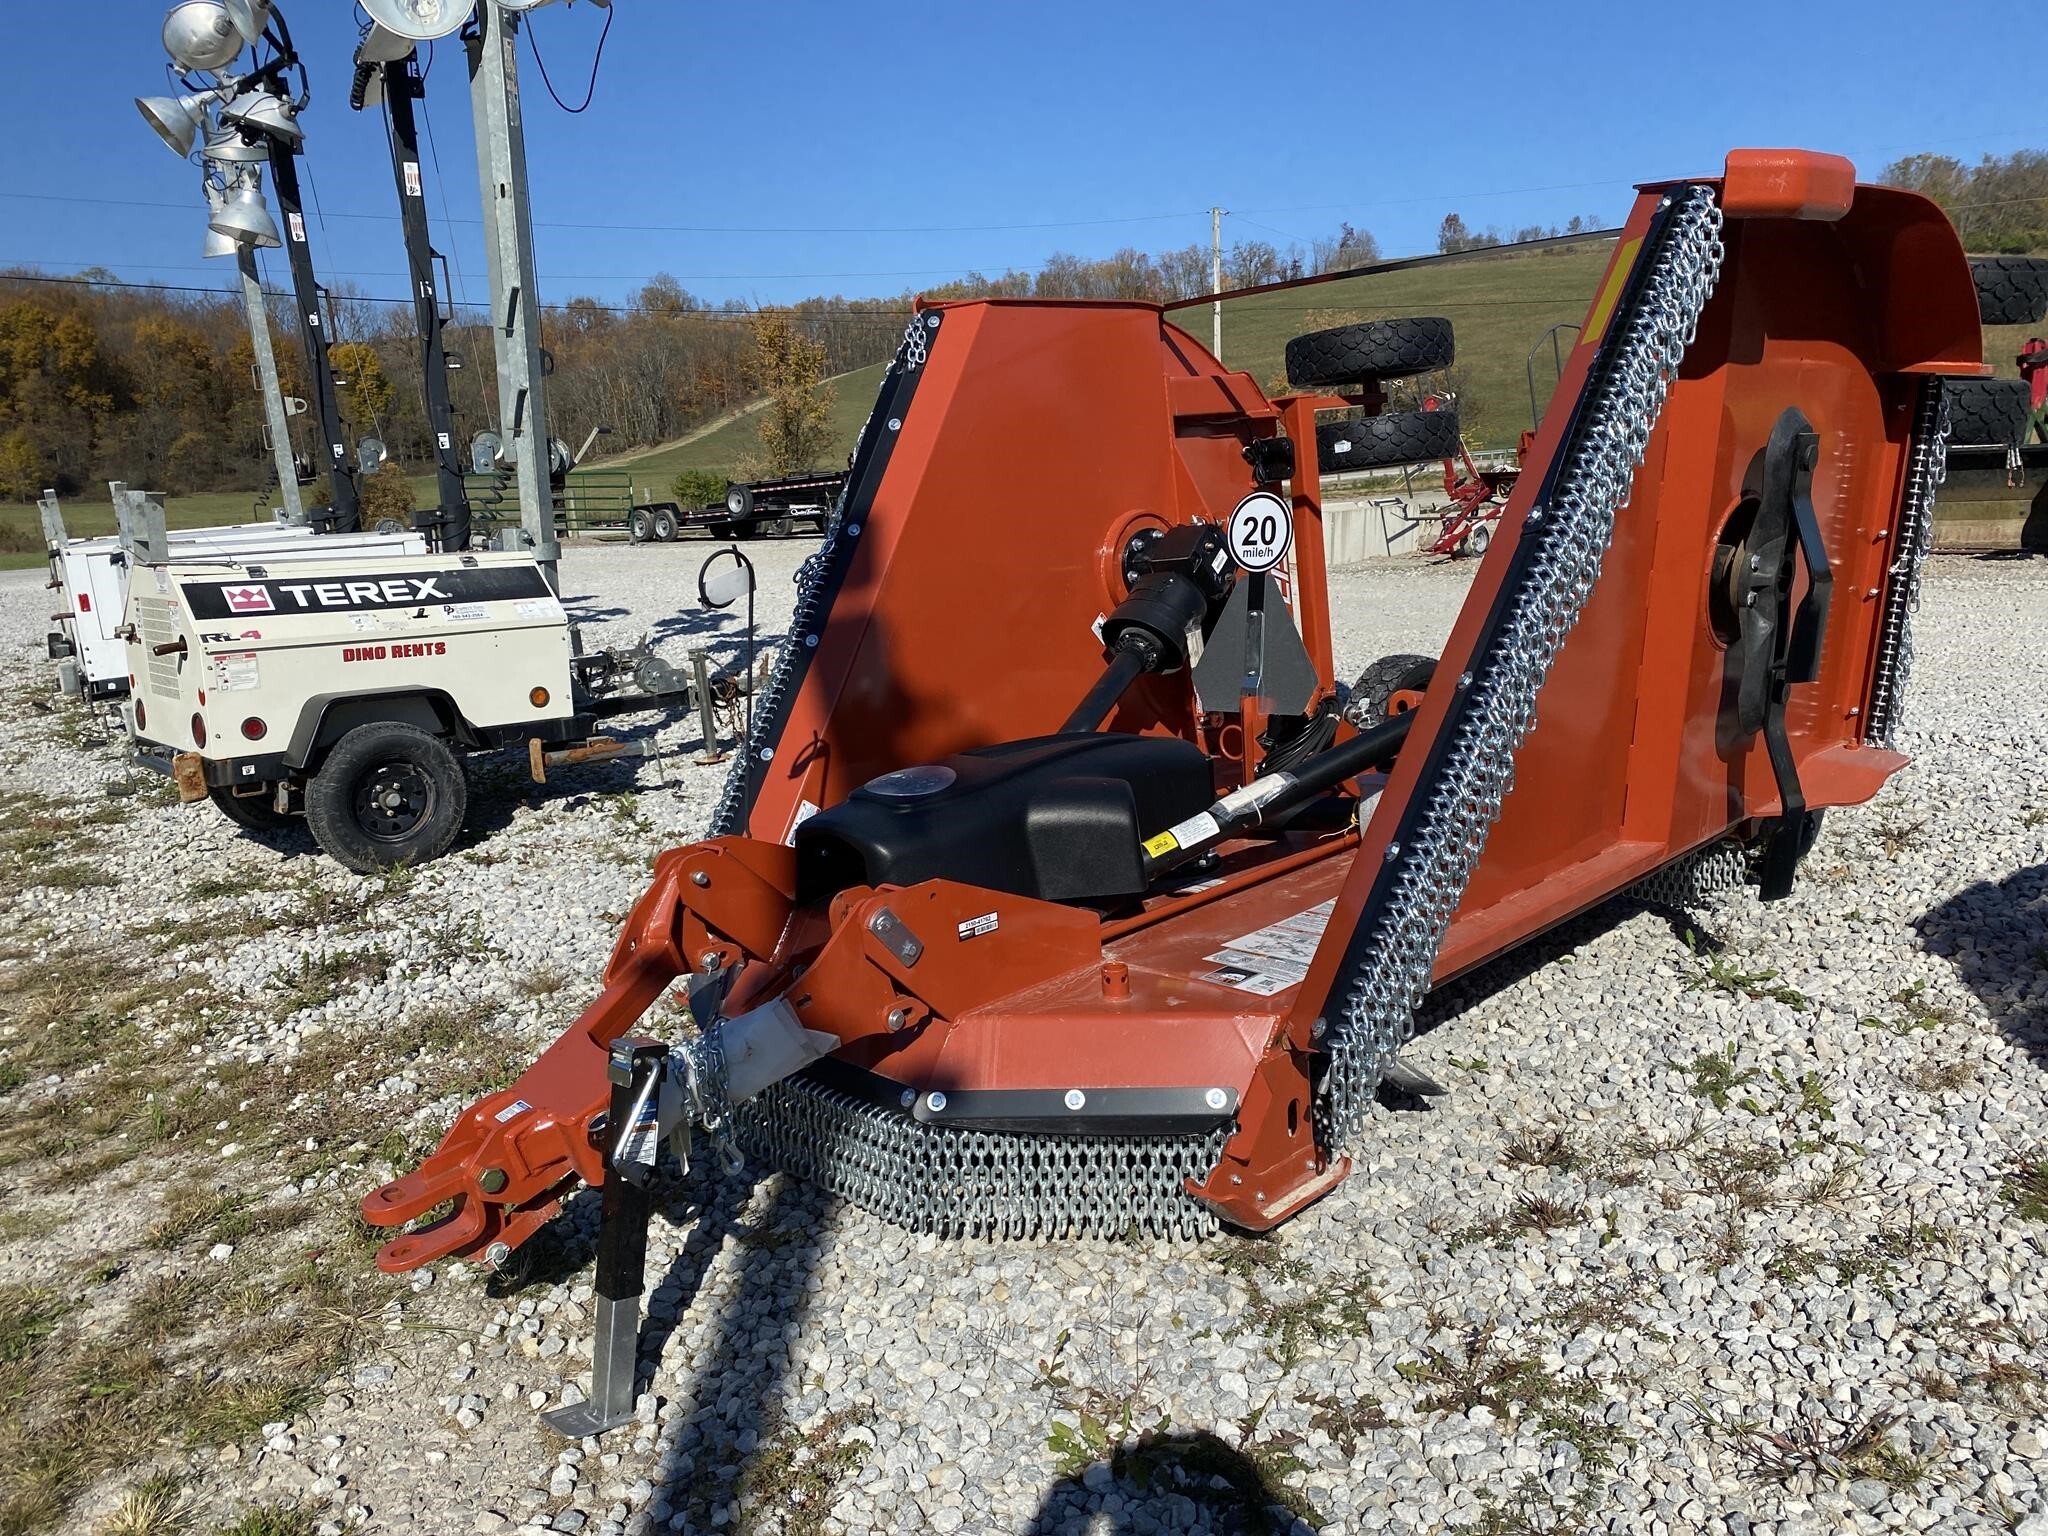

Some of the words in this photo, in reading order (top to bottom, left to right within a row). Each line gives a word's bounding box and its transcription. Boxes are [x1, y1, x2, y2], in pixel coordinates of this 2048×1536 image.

[1242, 515, 1277, 546] 20
[1242, 547, 1274, 558] mile/h
[278, 577, 449, 607] TEREX
[342, 646, 387, 662] DINO
[391, 642, 446, 658] RENTS
